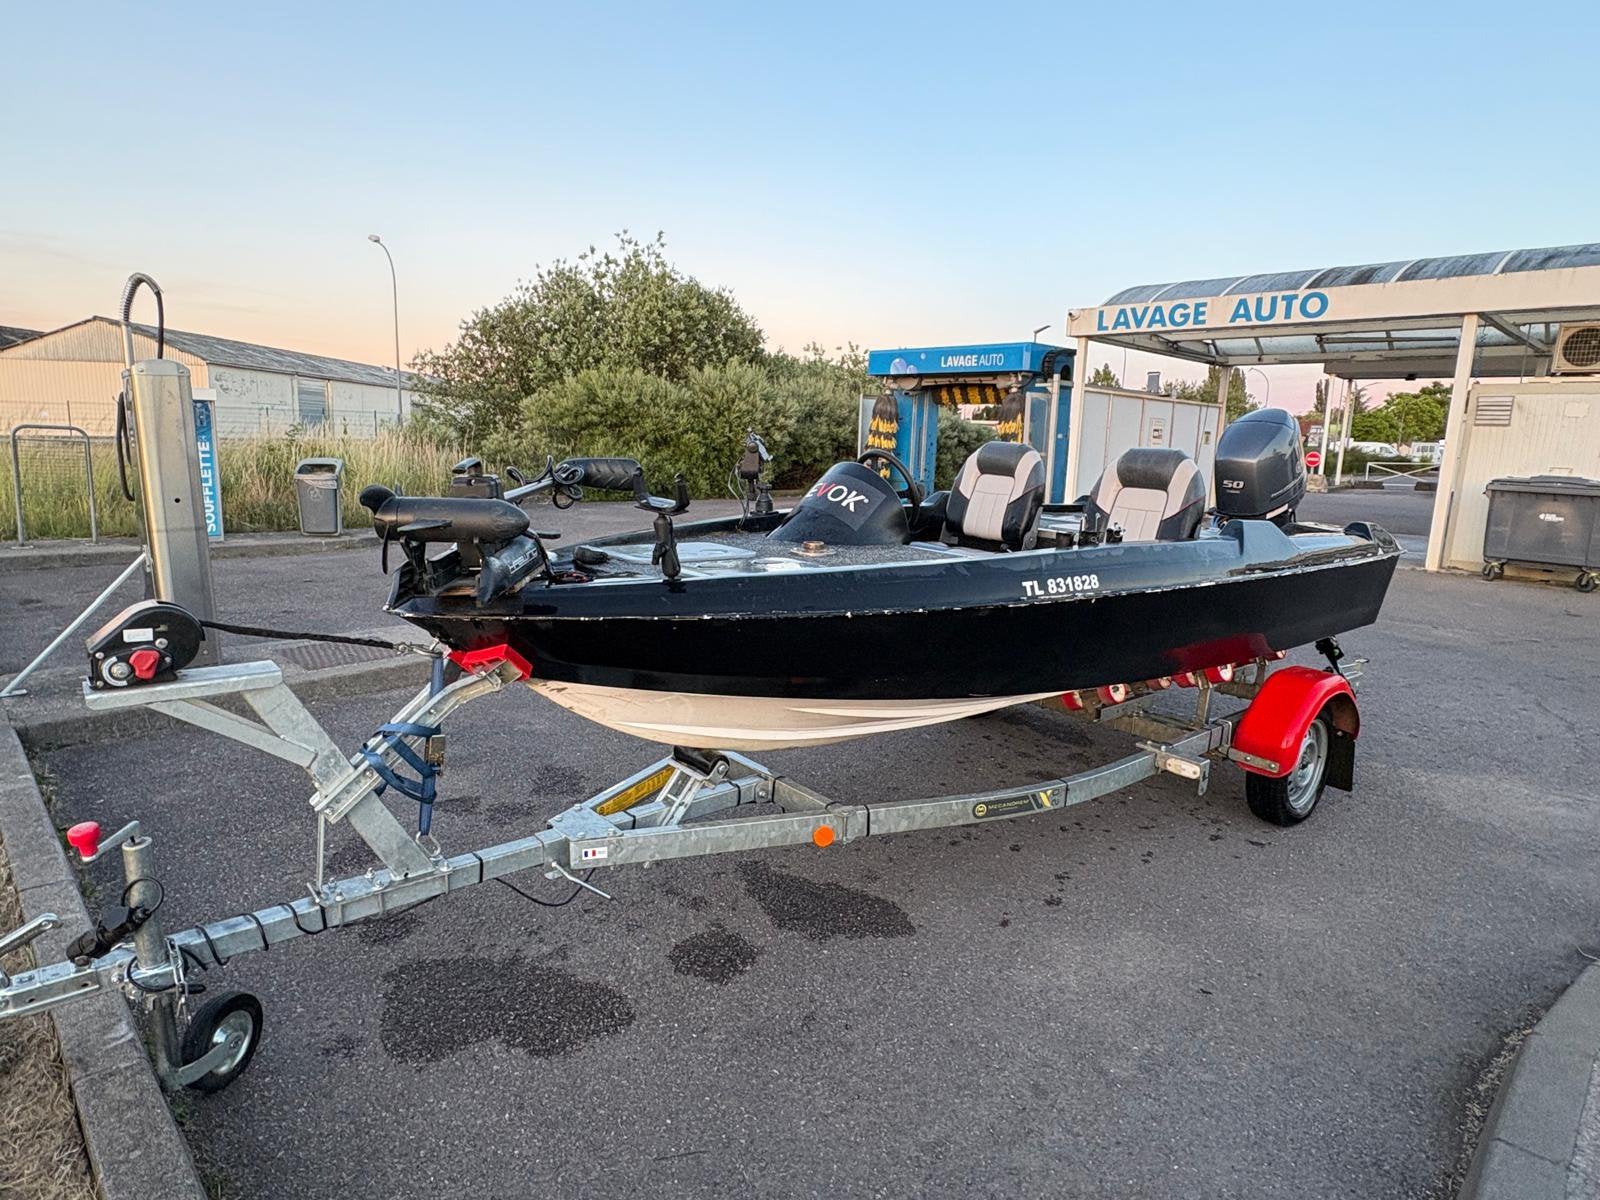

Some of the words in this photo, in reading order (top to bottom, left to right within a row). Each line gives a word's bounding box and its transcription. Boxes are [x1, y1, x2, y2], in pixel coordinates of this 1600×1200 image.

[1097, 301, 1208, 331] LAVAGE
[1229, 291, 1329, 324] AUTO
[941, 354, 978, 367] LAVAGE
[978, 353, 1004, 366] AUTO
[197, 441, 216, 533] SOUFFLETTE
[1222, 480, 1244, 489] 50
[1022, 580, 1045, 596] TL
[1047, 574, 1100, 594] 831828
